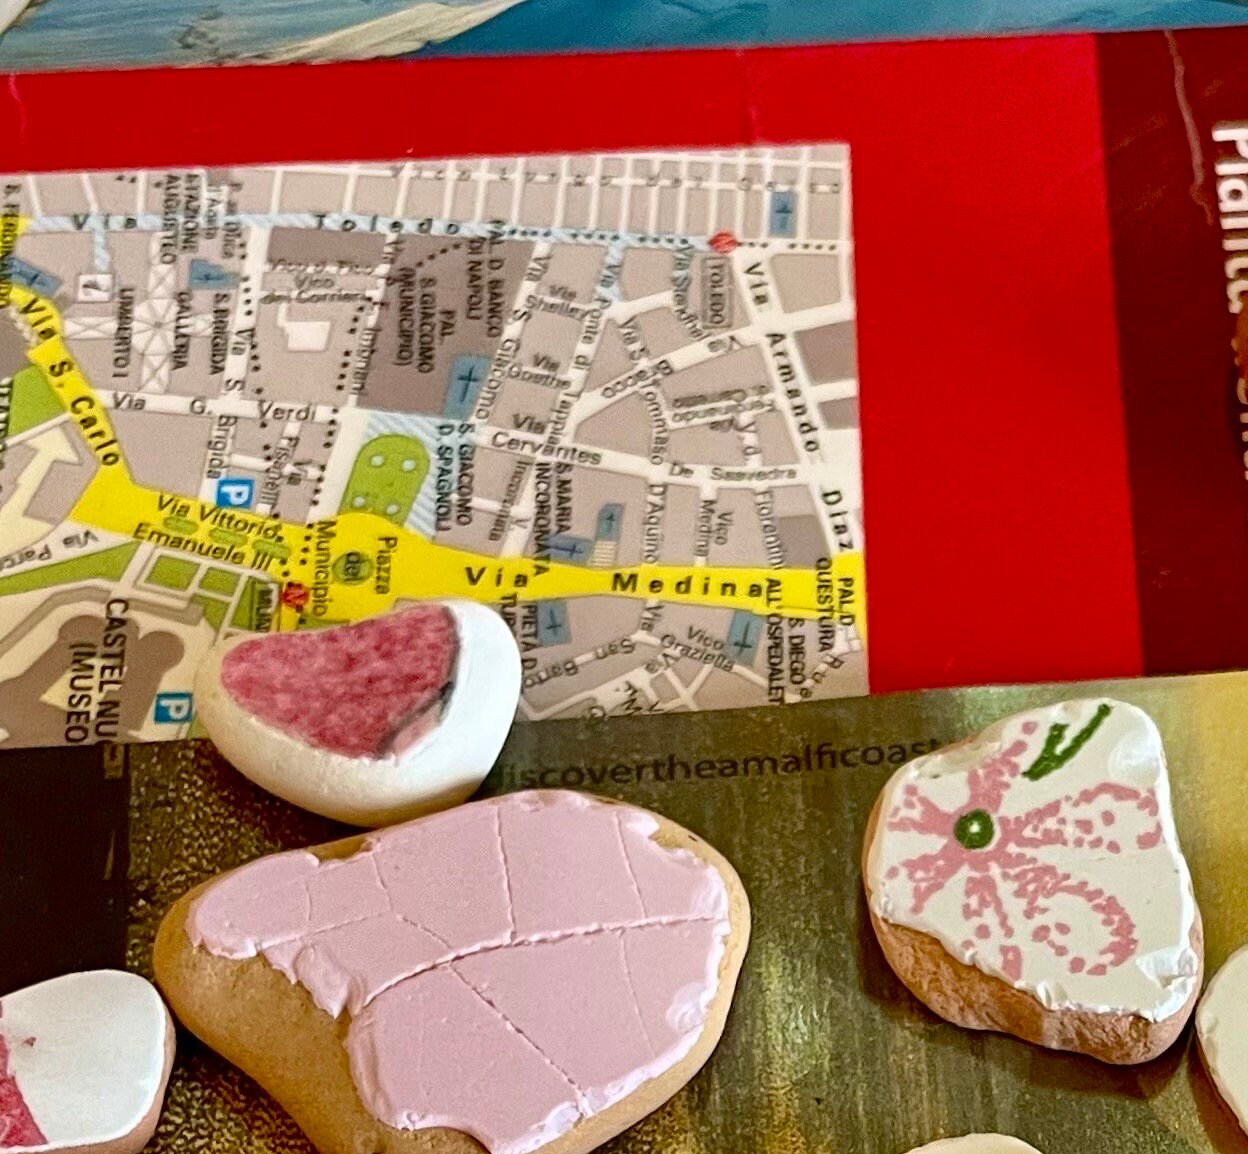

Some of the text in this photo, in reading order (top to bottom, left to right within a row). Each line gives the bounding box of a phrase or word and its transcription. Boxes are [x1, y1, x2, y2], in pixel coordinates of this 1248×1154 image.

[465, 260, 484, 321] NAPOLI
[486, 279, 504, 339] BANCO
[708, 261, 726, 326] TOLEDO
[113, 287, 135, 368] UMBERTO
[171, 291, 193, 371] GALLERIA
[234, 326, 256, 356] Via
[18, 297, 57, 340] Via
[70, 395, 120, 467] Carlo
[111, 391, 147, 411] Via
[257, 399, 316, 422] Verdi
[206, 414, 239, 479] Brigida
[491, 430, 603, 466] Cervantes
[764, 332, 821, 453] Armando
[820, 489, 855, 552] Diaz
[155, 490, 281, 540] Via Vittorio
[434, 445, 454, 533] SPAGNOLI
[455, 443, 475, 527] GIACOMO
[132, 519, 247, 566] Emanuele
[533, 461, 552, 577] INCORONATA
[693, 498, 718, 558] Medina
[310, 519, 338, 618] Municipio
[343, 550, 362, 583] del
[374, 535, 399, 595] Piazza
[464, 565, 762, 598] Via Medina
[816, 556, 836, 653] QUESTURA
[97, 598, 130, 693] CASTEL
[687, 625, 725, 651] Vico
[788, 634, 806, 685] DIEGO
